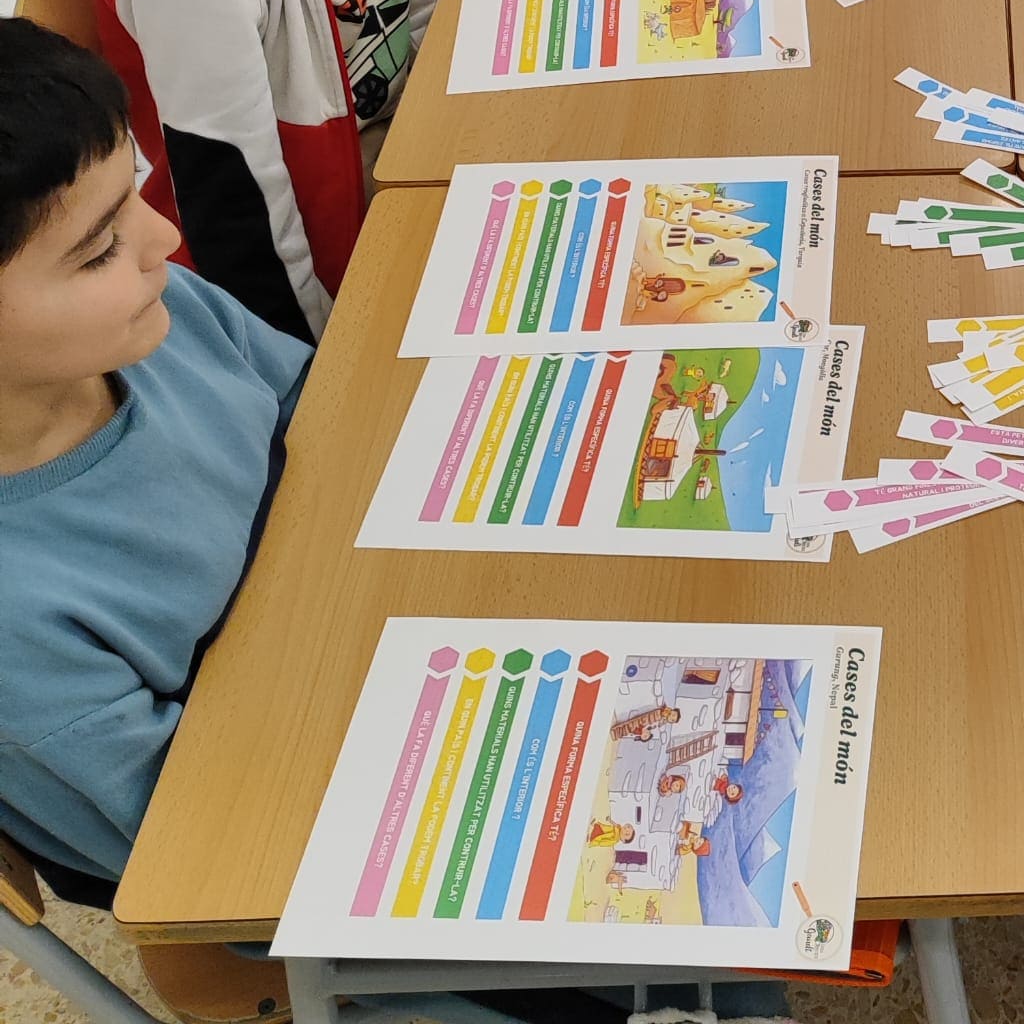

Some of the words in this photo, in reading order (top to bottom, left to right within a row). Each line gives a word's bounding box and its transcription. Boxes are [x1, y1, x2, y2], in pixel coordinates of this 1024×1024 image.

[810, 167, 827, 202] Cases
[809, 203, 825, 221] del
[807, 222, 824, 248] món
[827, 339, 851, 378] Cases
[598, 388, 613, 406] QUINA
[823, 379, 844, 402] del
[563, 399, 577, 412] COM
[592, 406, 608, 426] FORMA
[817, 404, 840, 437] món
[512, 455, 527, 468] PER
[829, 645, 845, 681] Gurung,
[841, 646, 866, 702] Cases
[499, 685, 517, 709] QUINS
[826, 683, 841, 710] Nepal
[413, 727, 428, 738] LA
[486, 709, 511, 754] MATERIALS
[569, 720, 585, 744] QUINA
[837, 705, 860, 736] del
[409, 739, 425, 751] FA
[525, 737, 541, 755] COM
[396, 751, 421, 791] DIFERENT
[481, 754, 498, 772] HAN
[562, 746, 579, 774] FORMA
[831, 739, 857, 785] món
[468, 772, 493, 818] UTILITZAT
[510, 767, 533, 813] L'INTERIOR
[550, 774, 572, 822] ESPECÍFICA
[383, 791, 408, 833] D'ALTRES
[463, 818, 481, 836] PER
[545, 824, 560, 841] TÉ?
[372, 833, 395, 868] CASES?
[445, 836, 475, 902] CONTRUIR-LA?
